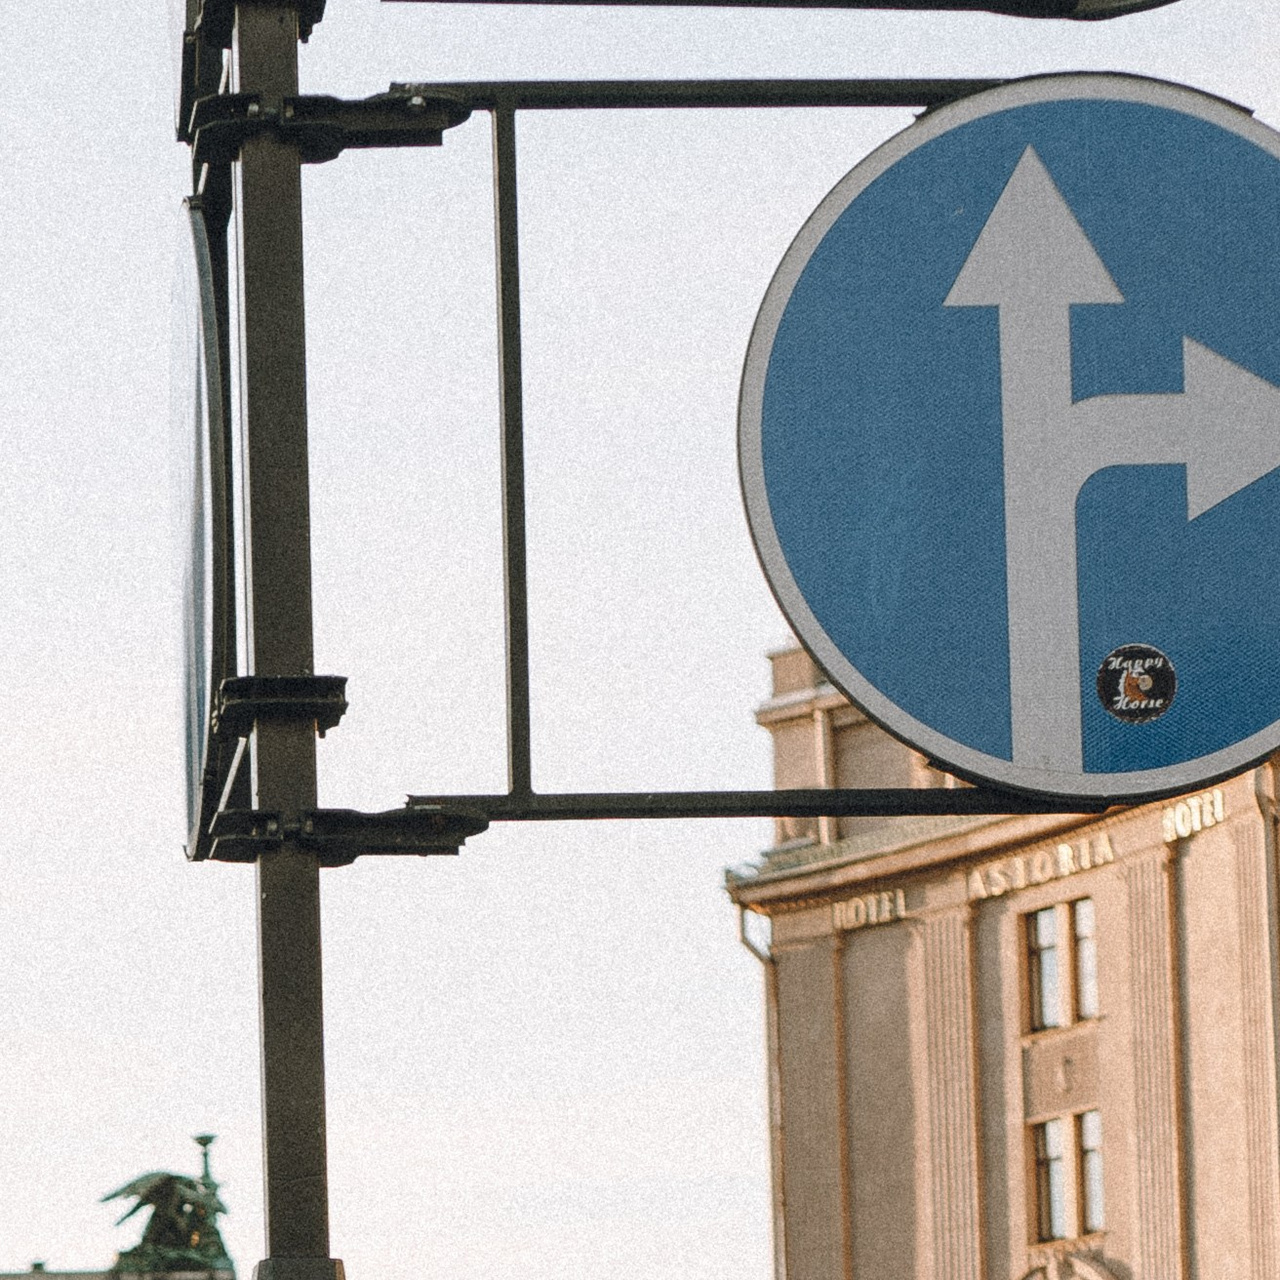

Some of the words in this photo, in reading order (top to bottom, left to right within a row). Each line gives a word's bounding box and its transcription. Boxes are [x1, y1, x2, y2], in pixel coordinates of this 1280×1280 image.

[1107, 656, 1164, 669] Happy
[1113, 696, 1164, 710] Horse
[1162, 788, 1226, 843] HOTEL
[966, 833, 1115, 900] ASTORIA
[833, 889, 908, 930] HOTEL
